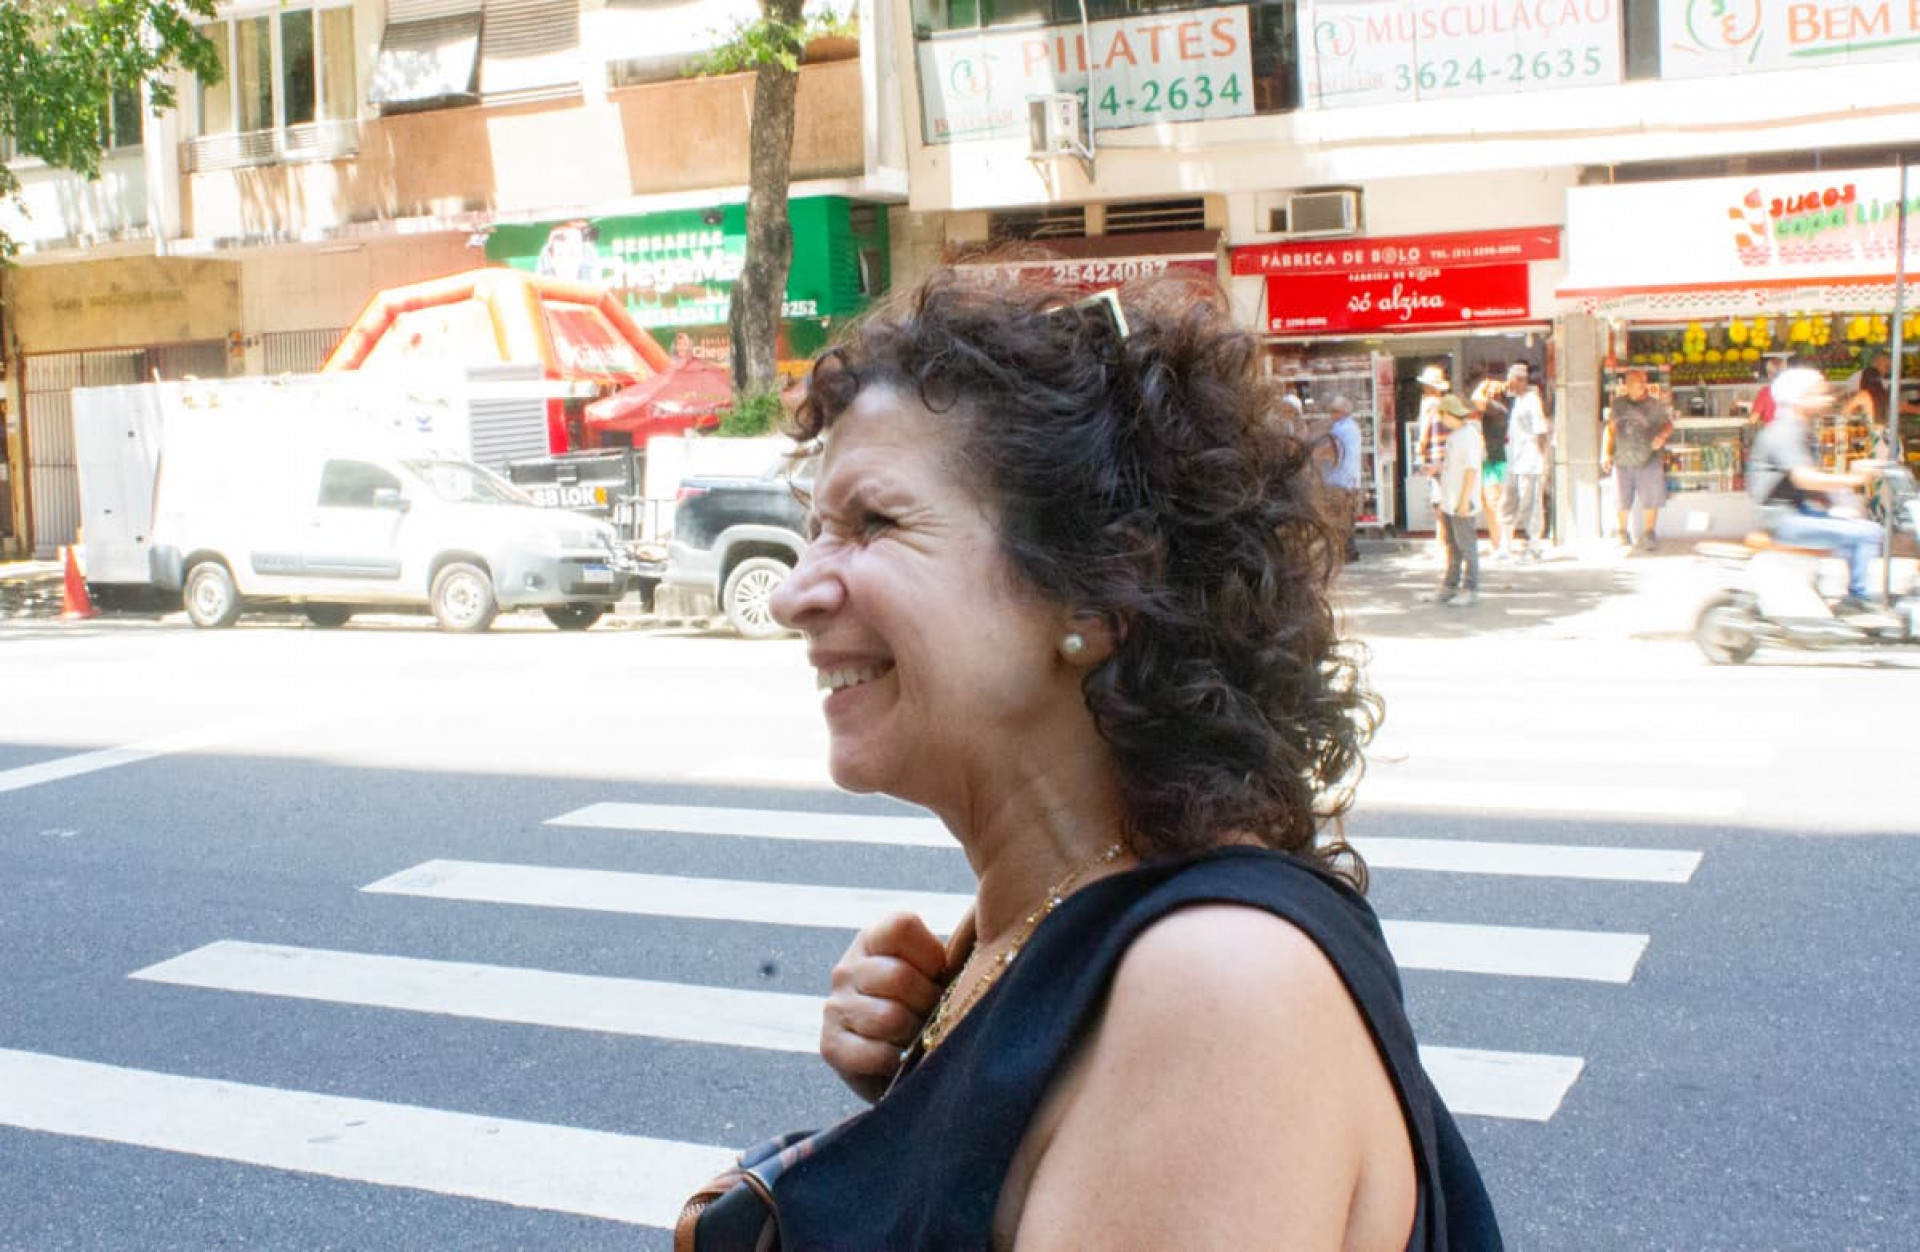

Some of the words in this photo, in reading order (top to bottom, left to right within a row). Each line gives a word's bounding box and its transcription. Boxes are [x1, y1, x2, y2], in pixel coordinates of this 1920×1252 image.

[1023, 17, 1238, 77] PILATES
[1396, 46, 1602, 92] 3624-2635
[1261, 250, 1335, 268] FÁBRICA
[1343, 250, 1363, 264] DE
